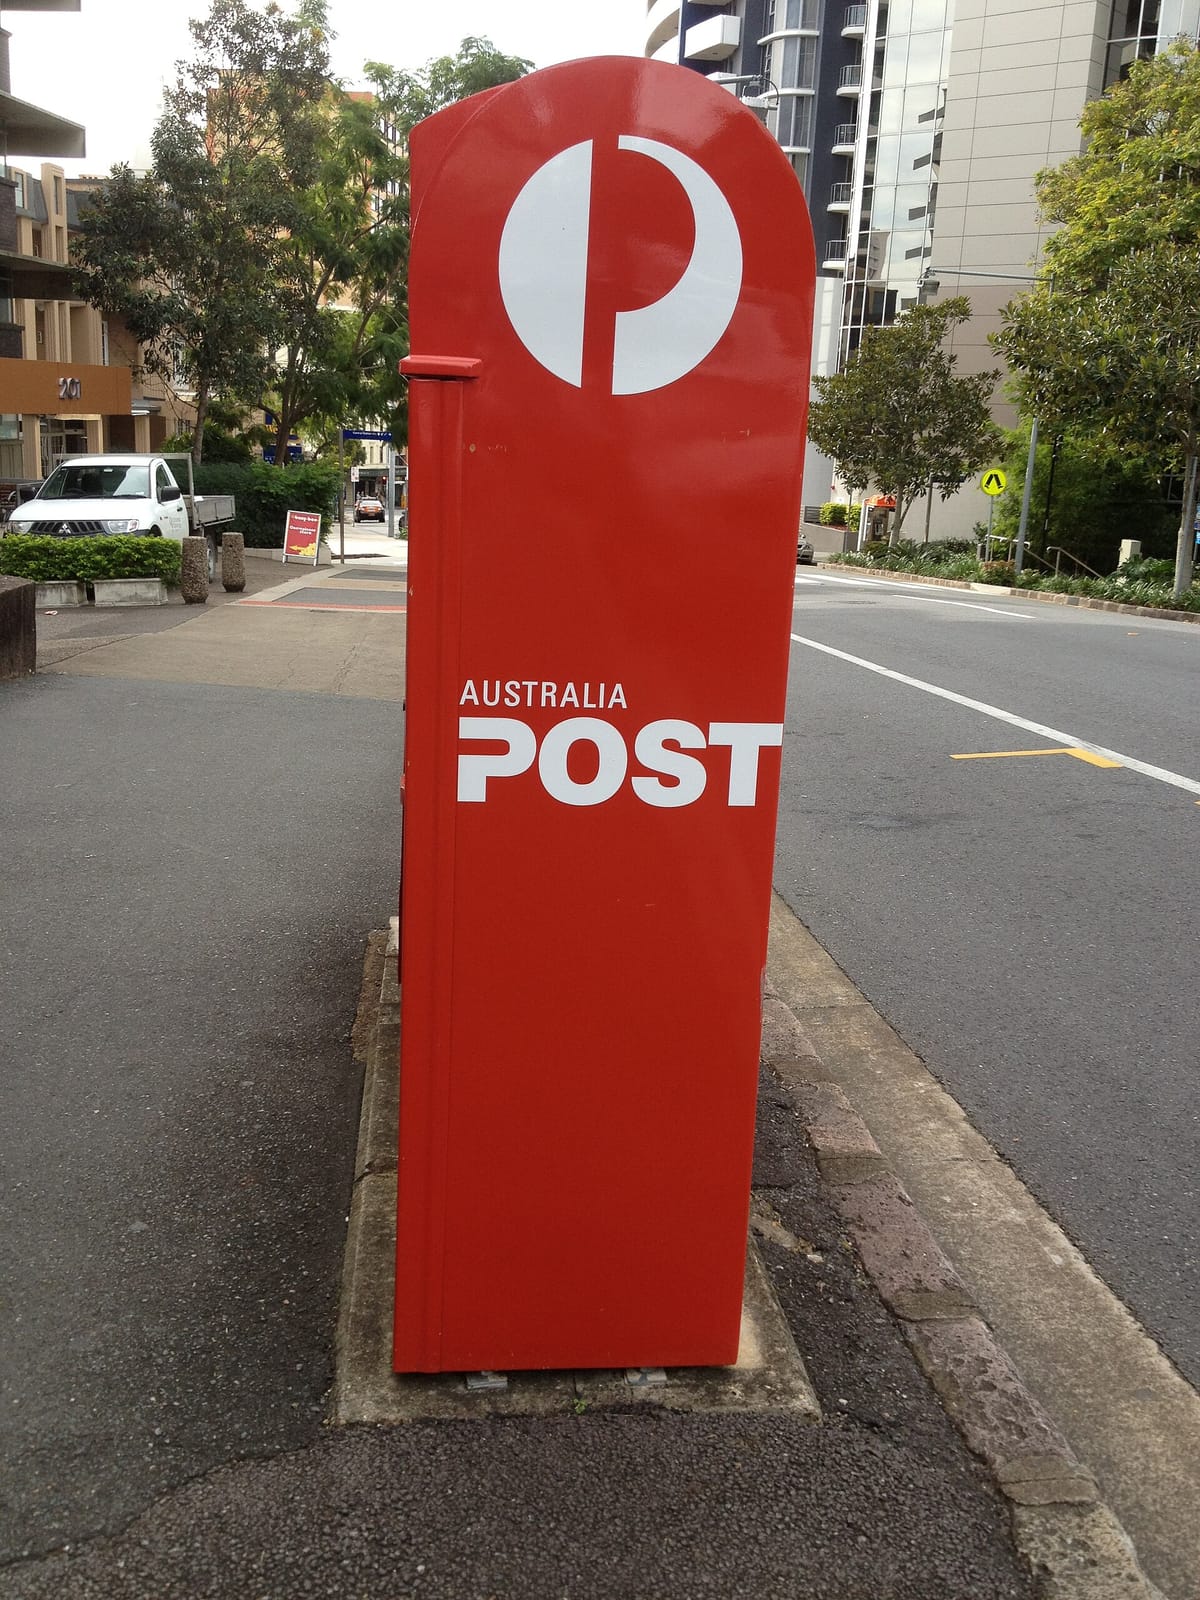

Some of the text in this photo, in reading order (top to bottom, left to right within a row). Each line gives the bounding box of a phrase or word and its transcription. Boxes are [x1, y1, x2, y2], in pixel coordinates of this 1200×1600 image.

[58, 377, 81, 399] 201
[459, 679, 628, 709] AUSTRALIA
[457, 716, 784, 808] POST
